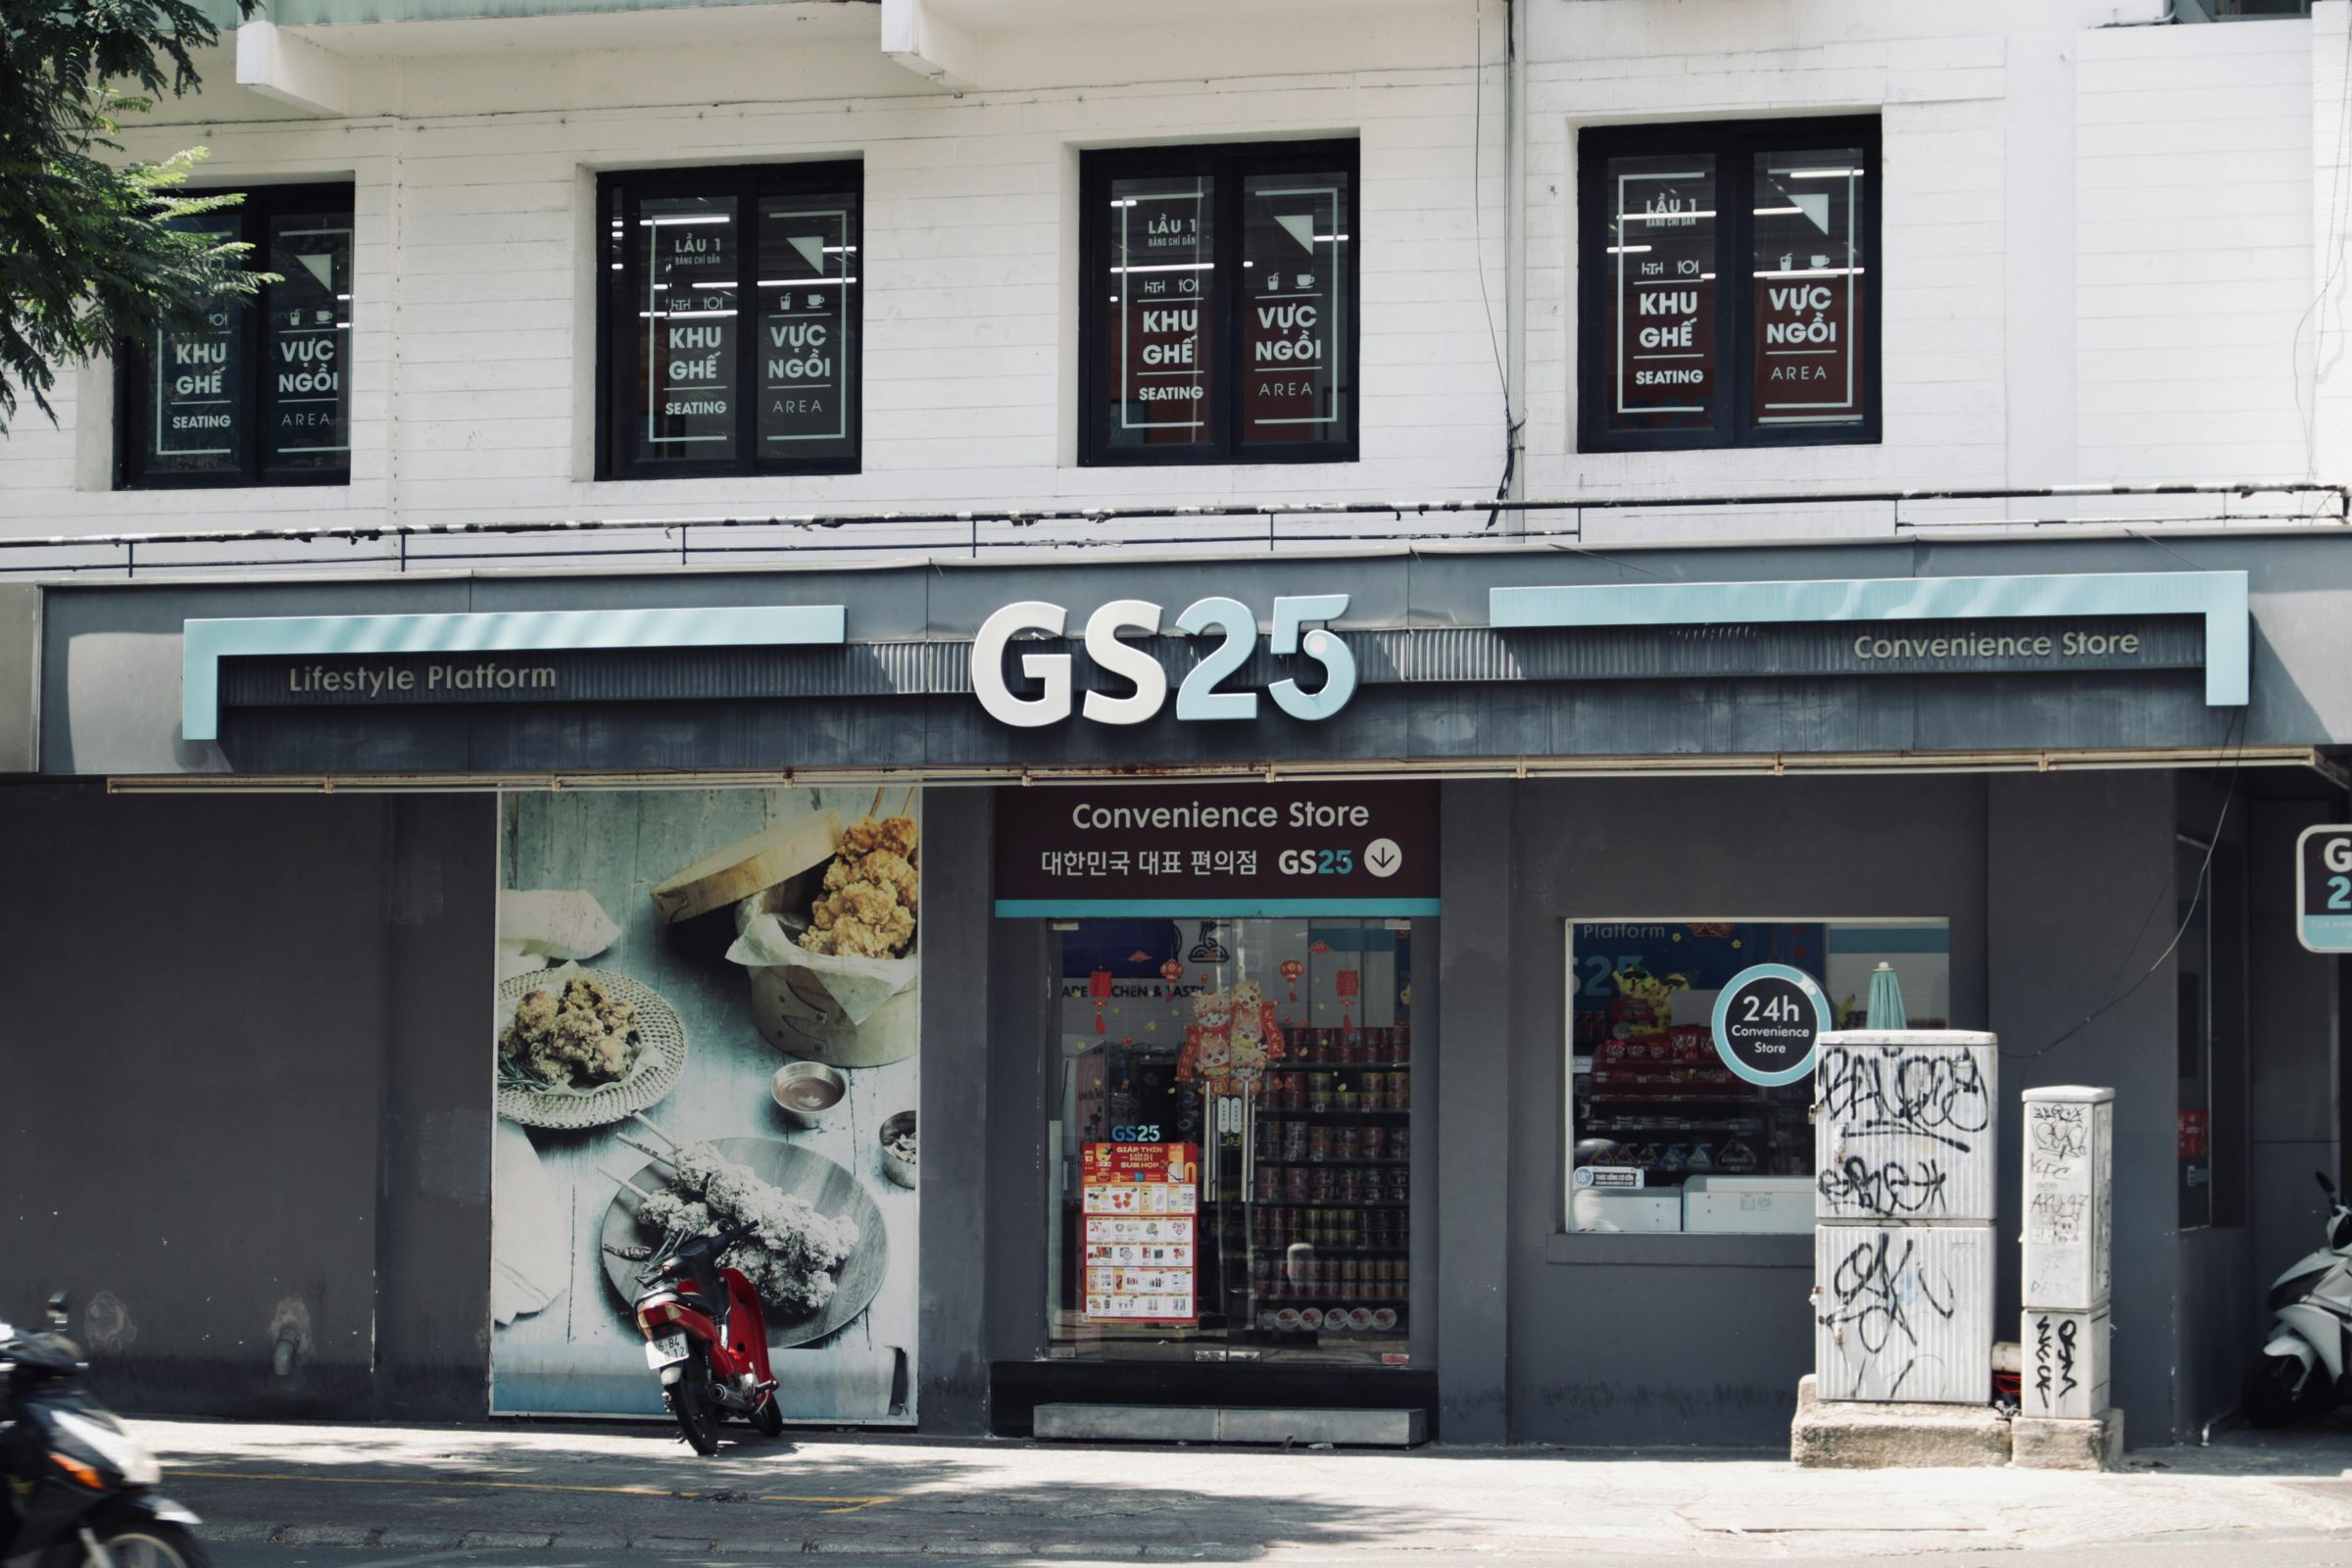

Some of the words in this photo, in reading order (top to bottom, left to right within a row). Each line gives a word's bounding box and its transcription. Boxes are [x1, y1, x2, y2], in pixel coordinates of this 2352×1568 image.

[1190, 219, 1197, 232] 1
[714, 238, 721, 252] 1
[1640, 292, 1697, 315] KHU
[1769, 284, 1832, 316] VỰC
[1143, 310, 1198, 333] KHU
[1257, 303, 1317, 334] VỰC
[1640, 318, 1697, 348] GHẾ
[1767, 312, 1836, 344] NGỒI
[669, 326, 721, 349] KHU
[770, 322, 826, 353] VỰC
[1143, 335, 1198, 365] GHẾ
[1255, 329, 1321, 362] NGỒI
[176, 343, 226, 365] KHU
[280, 338, 334, 367] VỰC
[668, 351, 721, 380] GHẾ
[768, 349, 830, 379] NGỒI
[176, 368, 225, 394] GHẾ
[278, 364, 338, 393] NGỒI
[1636, 369, 1703, 384] SEATING
[1771, 366, 1827, 380] AREA
[1139, 386, 1203, 401] SEATING
[1259, 382, 1312, 397] AREA
[172, 415, 231, 428] SEATING
[281, 413, 330, 426] AREA
[665, 401, 727, 416] SEATING
[773, 400, 822, 413] AREA
[1854, 632, 2052, 659] Convenience
[2062, 631, 2140, 657] Store
[971, 594, 1357, 727] GS25
[290, 665, 415, 698] Lifestyle
[428, 662, 557, 690] Platform
[1072, 801, 1279, 829] Convenience
[1289, 801, 1370, 828] Store
[1042, 851, 1131, 877] 대한민국
[1139, 851, 1182, 876] 대표
[1190, 850, 1257, 876] 편의점
[1278, 849, 1353, 876] GS25
[1583, 924, 1665, 939] Platform
[1102, 985, 1148, 997] CHEN
[1166, 985, 1205, 997] ASTY
[1742, 996, 1800, 1022] 24h
[1732, 1025, 1810, 1039] Convenience
[1754, 1041, 1787, 1054] Store
[1111, 1124, 1161, 1142] GS25
